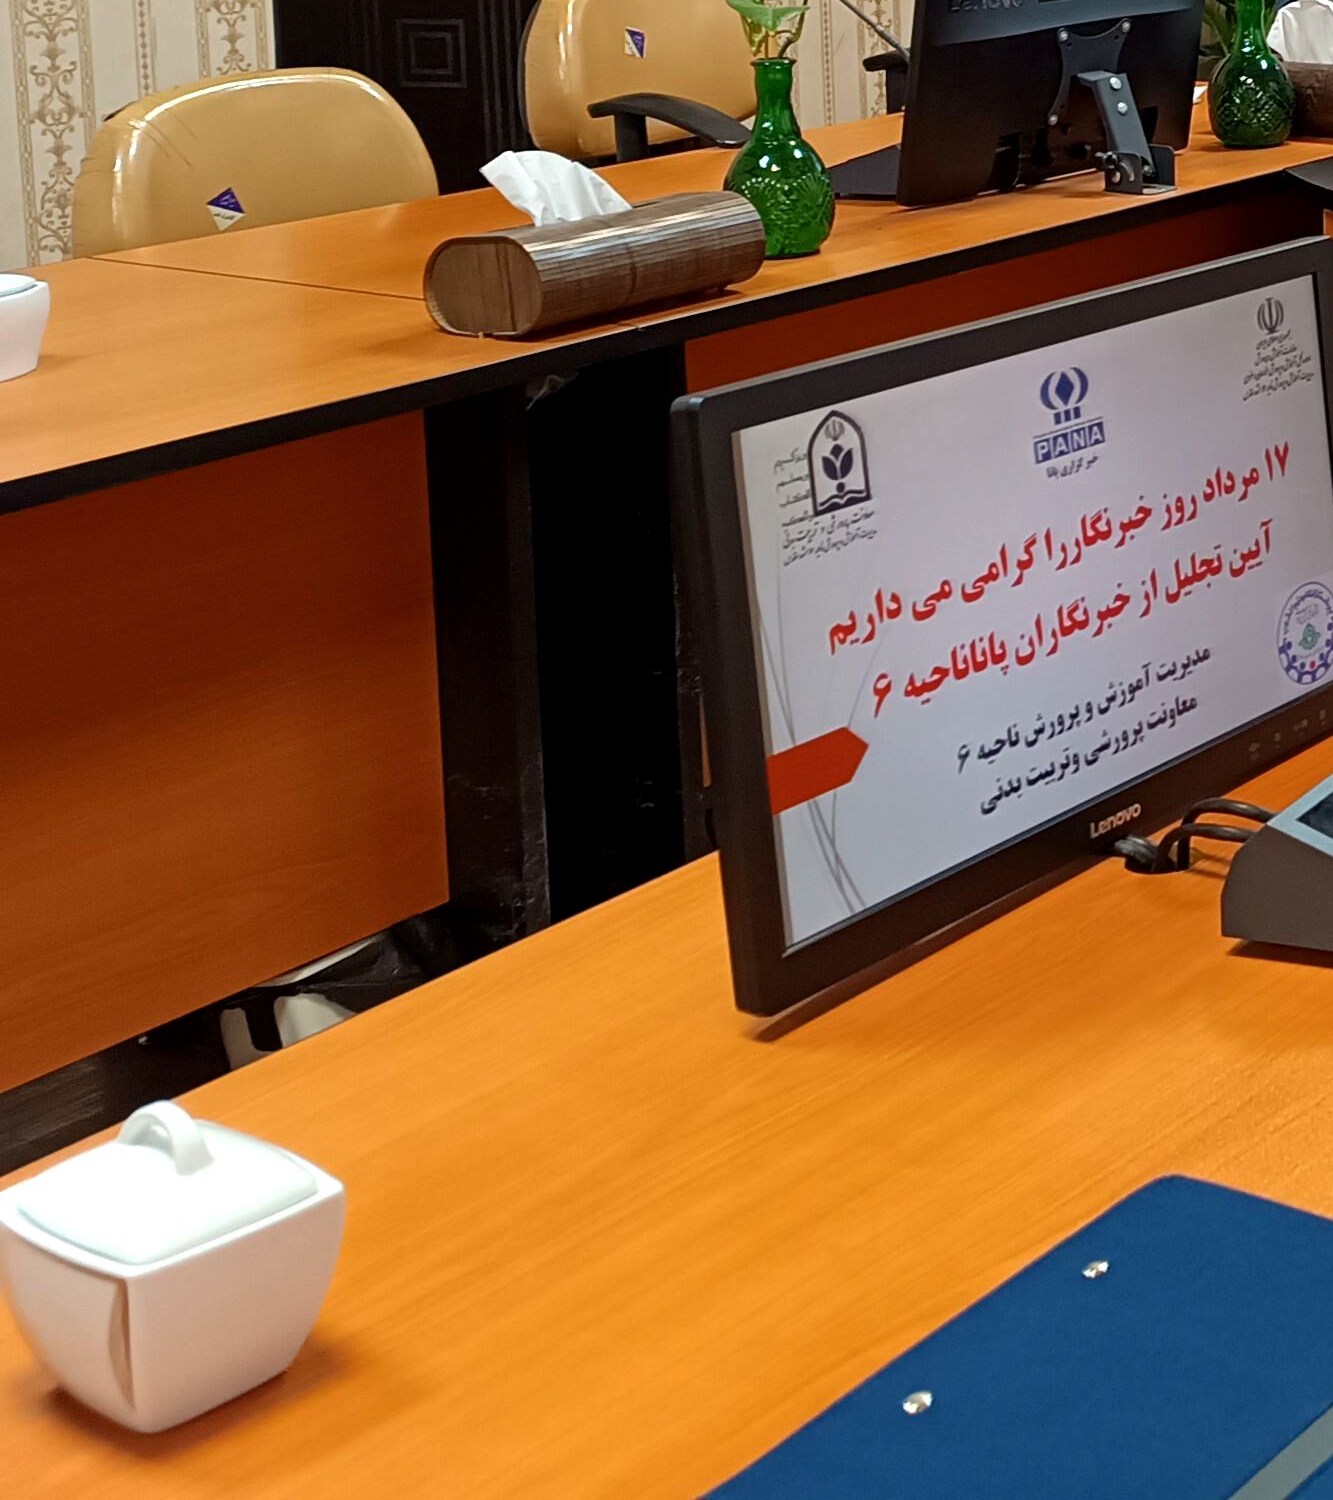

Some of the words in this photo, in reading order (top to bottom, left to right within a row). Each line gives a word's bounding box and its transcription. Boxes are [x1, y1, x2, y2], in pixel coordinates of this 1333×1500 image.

[1034, 421, 1105, 464] PANA
[1265, 441, 1289, 482] ۱۷
[1202, 466, 1259, 502] مرداد
[1161, 493, 1198, 531] روز
[961, 532, 1037, 603] گرامی
[1229, 518, 1273, 578] آیین
[1139, 568, 1158, 618] از
[1165, 544, 1223, 604] تجلیل
[912, 579, 953, 621] می
[829, 588, 902, 656] داریم
[1015, 583, 1131, 667] خبرنگاران
[1156, 646, 1212, 681] مدیریت
[872, 673, 893, 719] ۶
[1097, 662, 1151, 715] آموزش
[1024, 702, 1082, 748] پرورش
[1084, 701, 1094, 723] و
[1146, 694, 1198, 729] معاونت
[957, 744, 971, 775] ۶
[977, 723, 1020, 765] ناحیه
[1084, 720, 1145, 766] پرورشی
[979, 775, 1022, 816] بدنی
[1090, 802, 1142, 839] Lenovo
